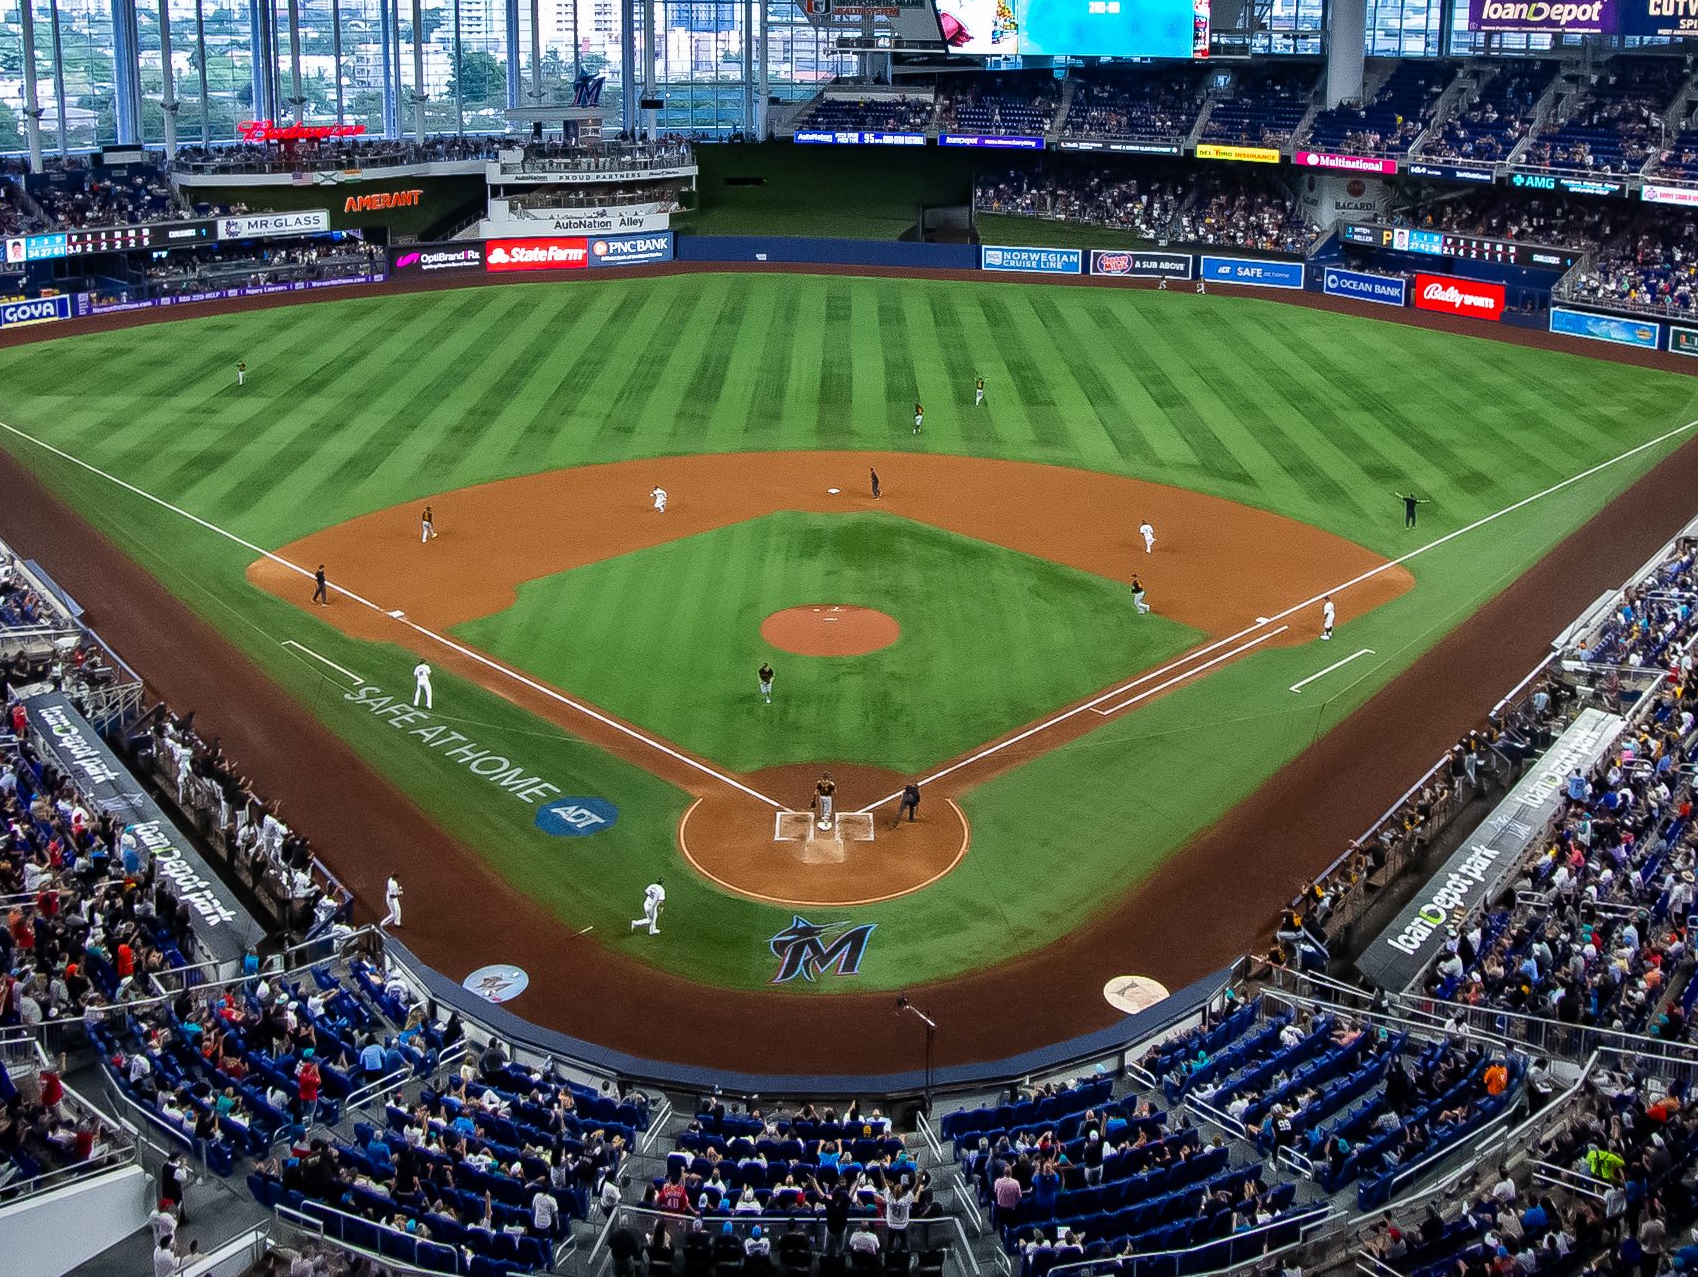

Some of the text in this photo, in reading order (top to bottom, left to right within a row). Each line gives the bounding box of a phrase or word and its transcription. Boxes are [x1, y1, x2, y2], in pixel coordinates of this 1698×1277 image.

[1482, 0, 1602, 25] loanDepot
[238, 120, 366, 143] Budweiser
[1320, 155, 1383, 171] Multinational
[596, 173, 641, 181] PARTNERS
[1525, 176, 1555, 189] AMG
[344, 189, 423, 213] AMERANT
[554, 216, 644, 230] AutoNation Alley
[68, 244, 82, 254] 3.0
[1003, 251, 1078, 263] NORWEGIAN
[1003, 260, 1063, 269] CRUISE LINE
[1142, 261, 1157, 269] SUB
[1159, 262, 1185, 271] ABOVE
[1237, 266, 1262, 278] SAFE
[1340, 279, 1401, 297] OCEAN BANK
[1424, 283, 1495, 309] Bally SPORTS
[5, 302, 55, 322] GOYA
[38, 706, 119, 784] loanDepot park
[344, 686, 605, 829] SAFE AT HOME ADT
[134, 820, 237, 926] loanDepot park
[1387, 844, 1500, 955] loanDepot park
